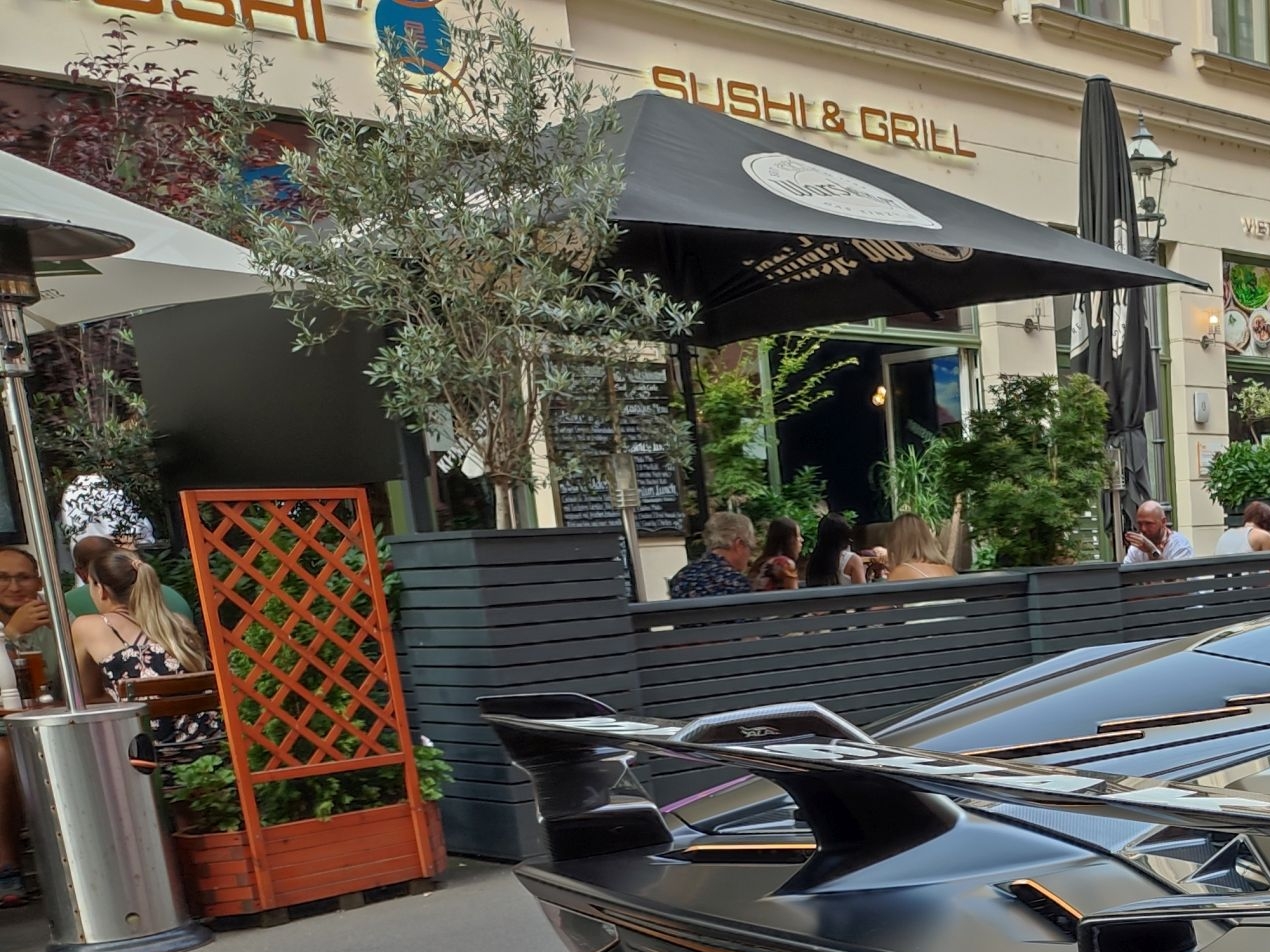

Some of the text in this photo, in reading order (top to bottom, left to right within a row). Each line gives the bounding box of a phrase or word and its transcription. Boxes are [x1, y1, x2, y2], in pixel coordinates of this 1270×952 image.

[652, 66, 977, 158] SUSHI & GRILL
